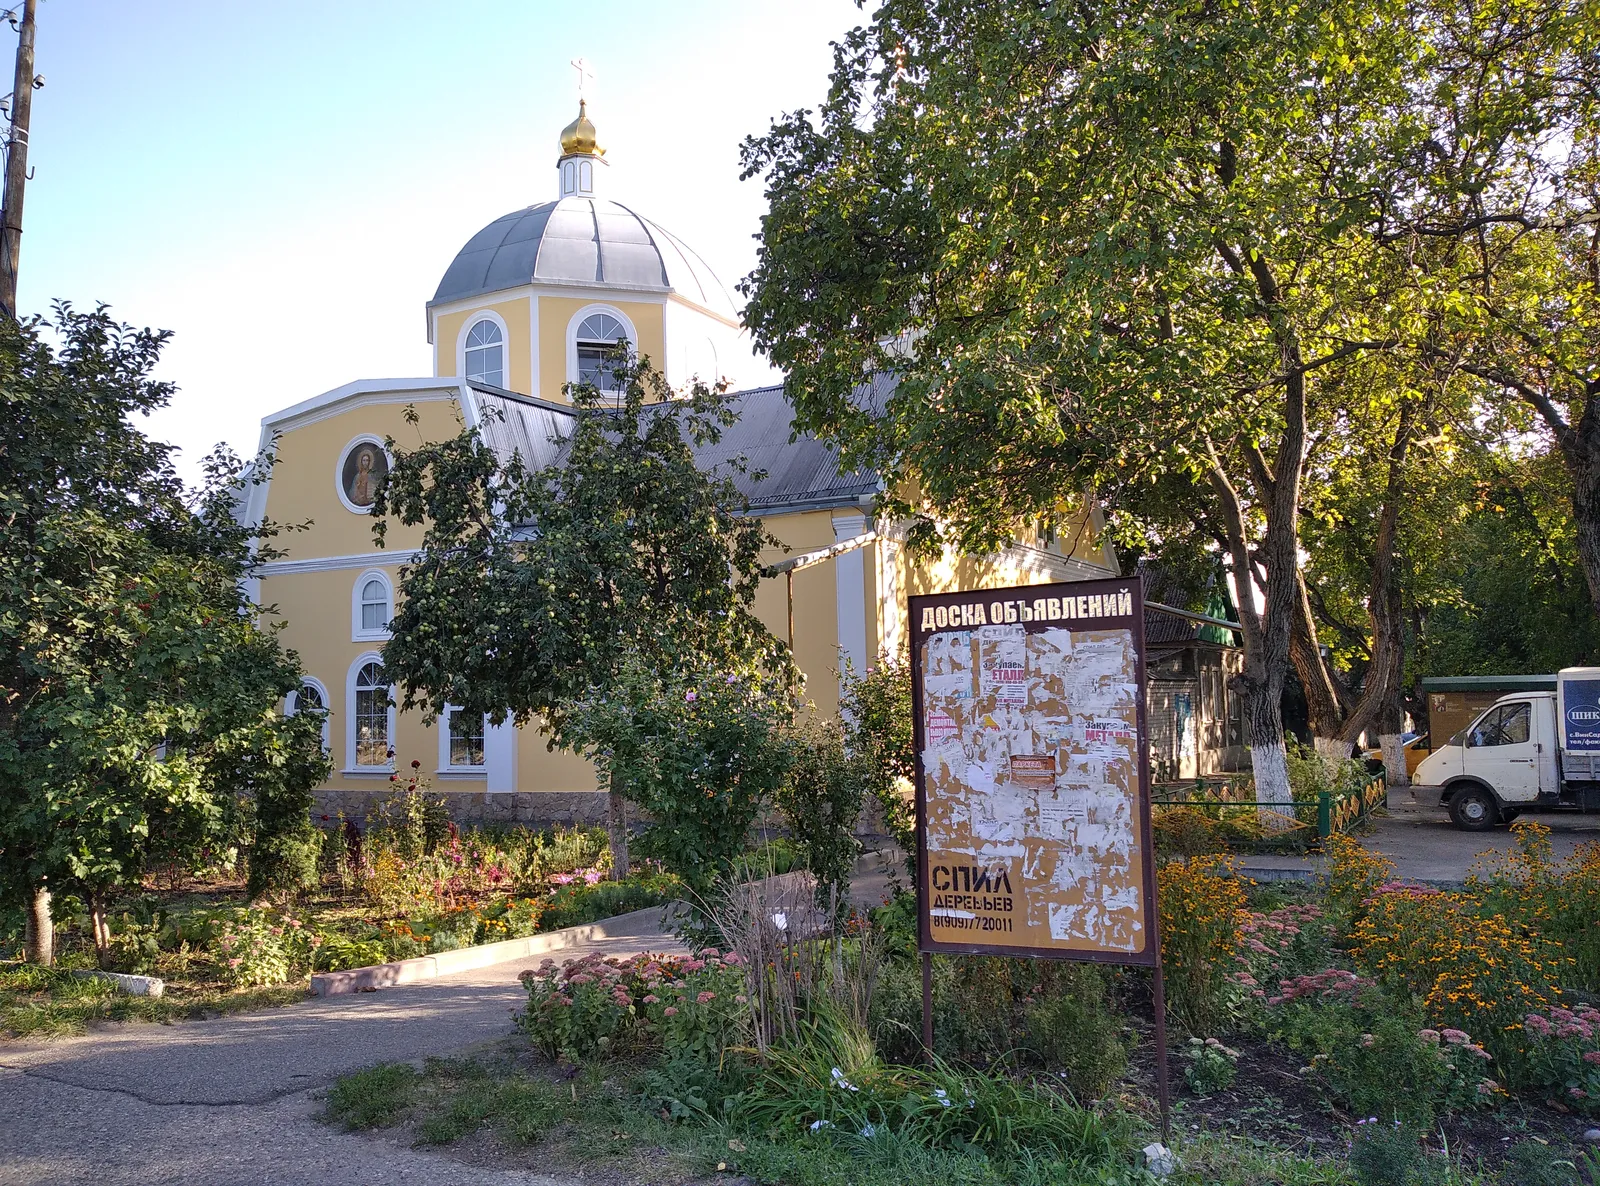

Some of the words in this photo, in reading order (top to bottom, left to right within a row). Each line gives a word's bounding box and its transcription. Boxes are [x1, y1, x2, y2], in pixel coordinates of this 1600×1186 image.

[921, 602, 987, 632] ДОСКА
[990, 588, 1133, 625] ОБЪЯВЛЕНИЙ
[1571, 711, 1600, 720] ШИК
[932, 865, 1013, 894] СПИЛ
